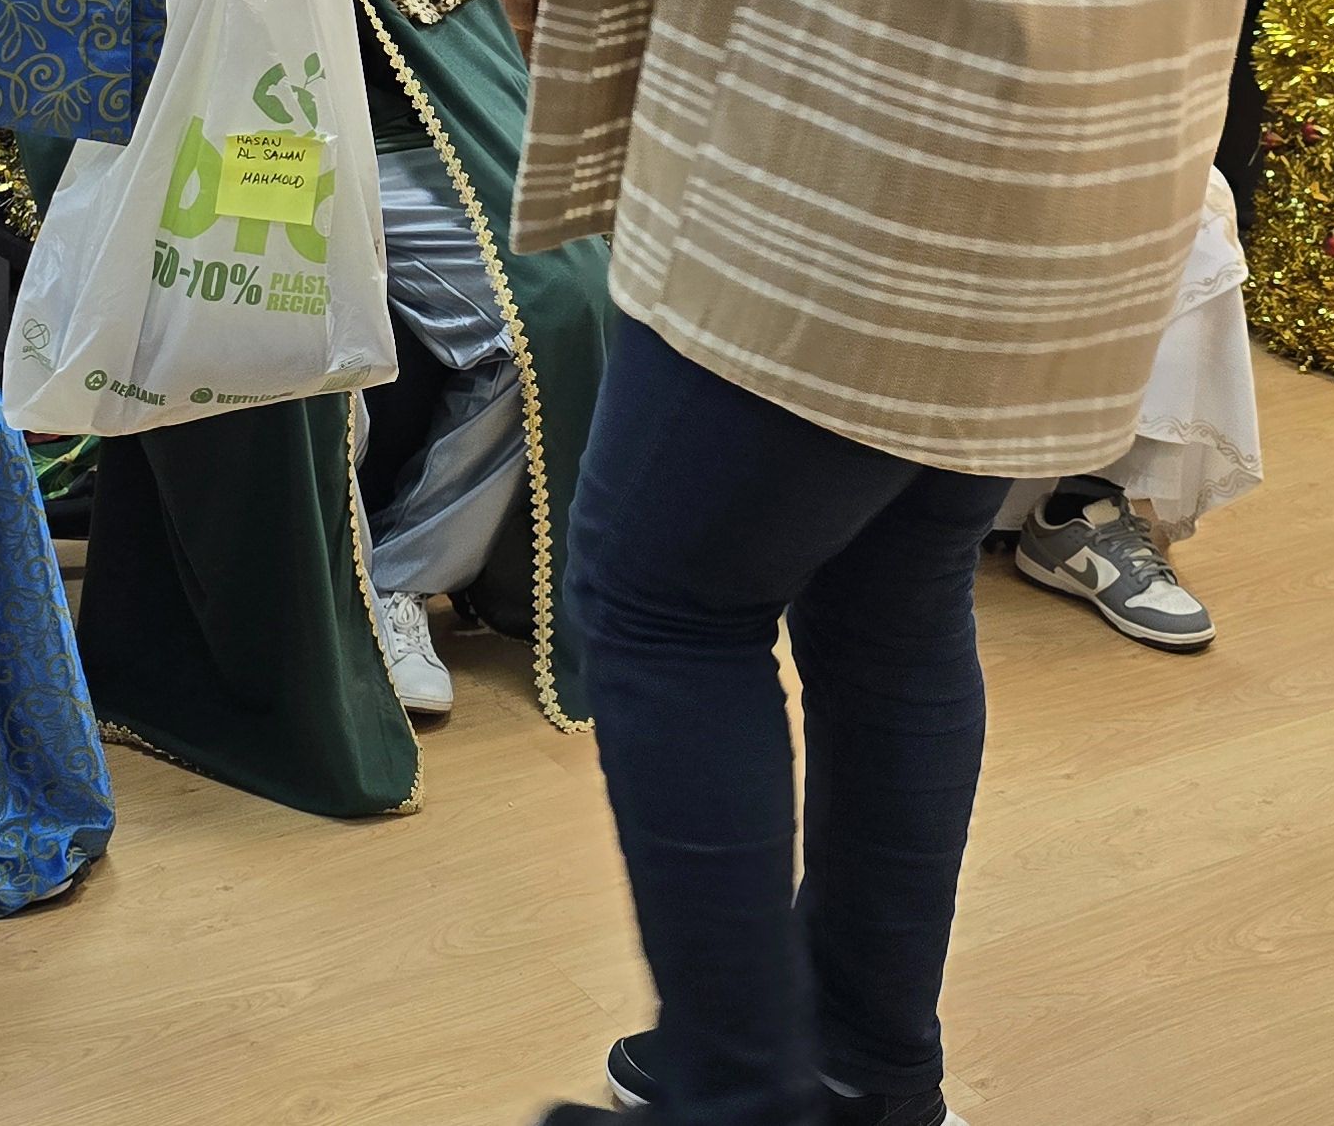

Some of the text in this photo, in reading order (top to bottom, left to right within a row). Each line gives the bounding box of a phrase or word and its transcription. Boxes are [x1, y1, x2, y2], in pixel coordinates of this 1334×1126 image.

[236, 135, 282, 147] HASAN
[236, 147, 256, 159] AL
[240, 172, 305, 189] MAHMOUD
[269, 271, 327, 296] PLÁST
[266, 293, 327, 316] RECIC
